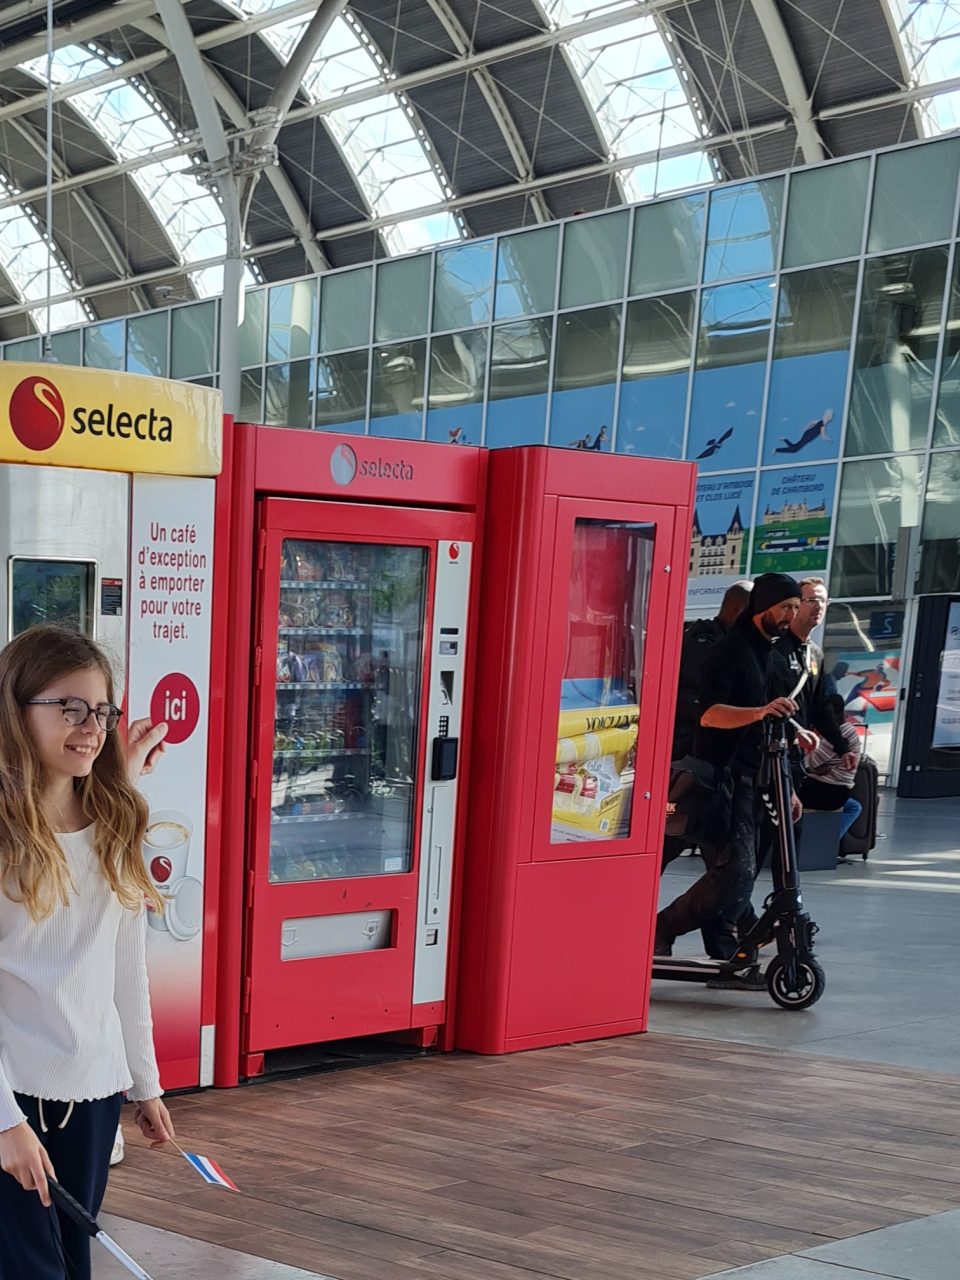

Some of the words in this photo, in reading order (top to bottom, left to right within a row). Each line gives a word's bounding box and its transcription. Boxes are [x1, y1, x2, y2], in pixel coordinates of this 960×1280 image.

[70, 403, 174, 443] selecta
[358, 457, 415, 481] selecta
[150, 521, 167, 542] Un
[170, 523, 197, 544] café
[138, 545, 207, 572] d'exception
[138, 569, 146, 590] à
[150, 574, 205, 596] emporter
[140, 599, 169, 619] pour
[171, 598, 202, 617] votre
[153, 620, 189, 644] trajet.
[163, 690, 188, 722] ici
